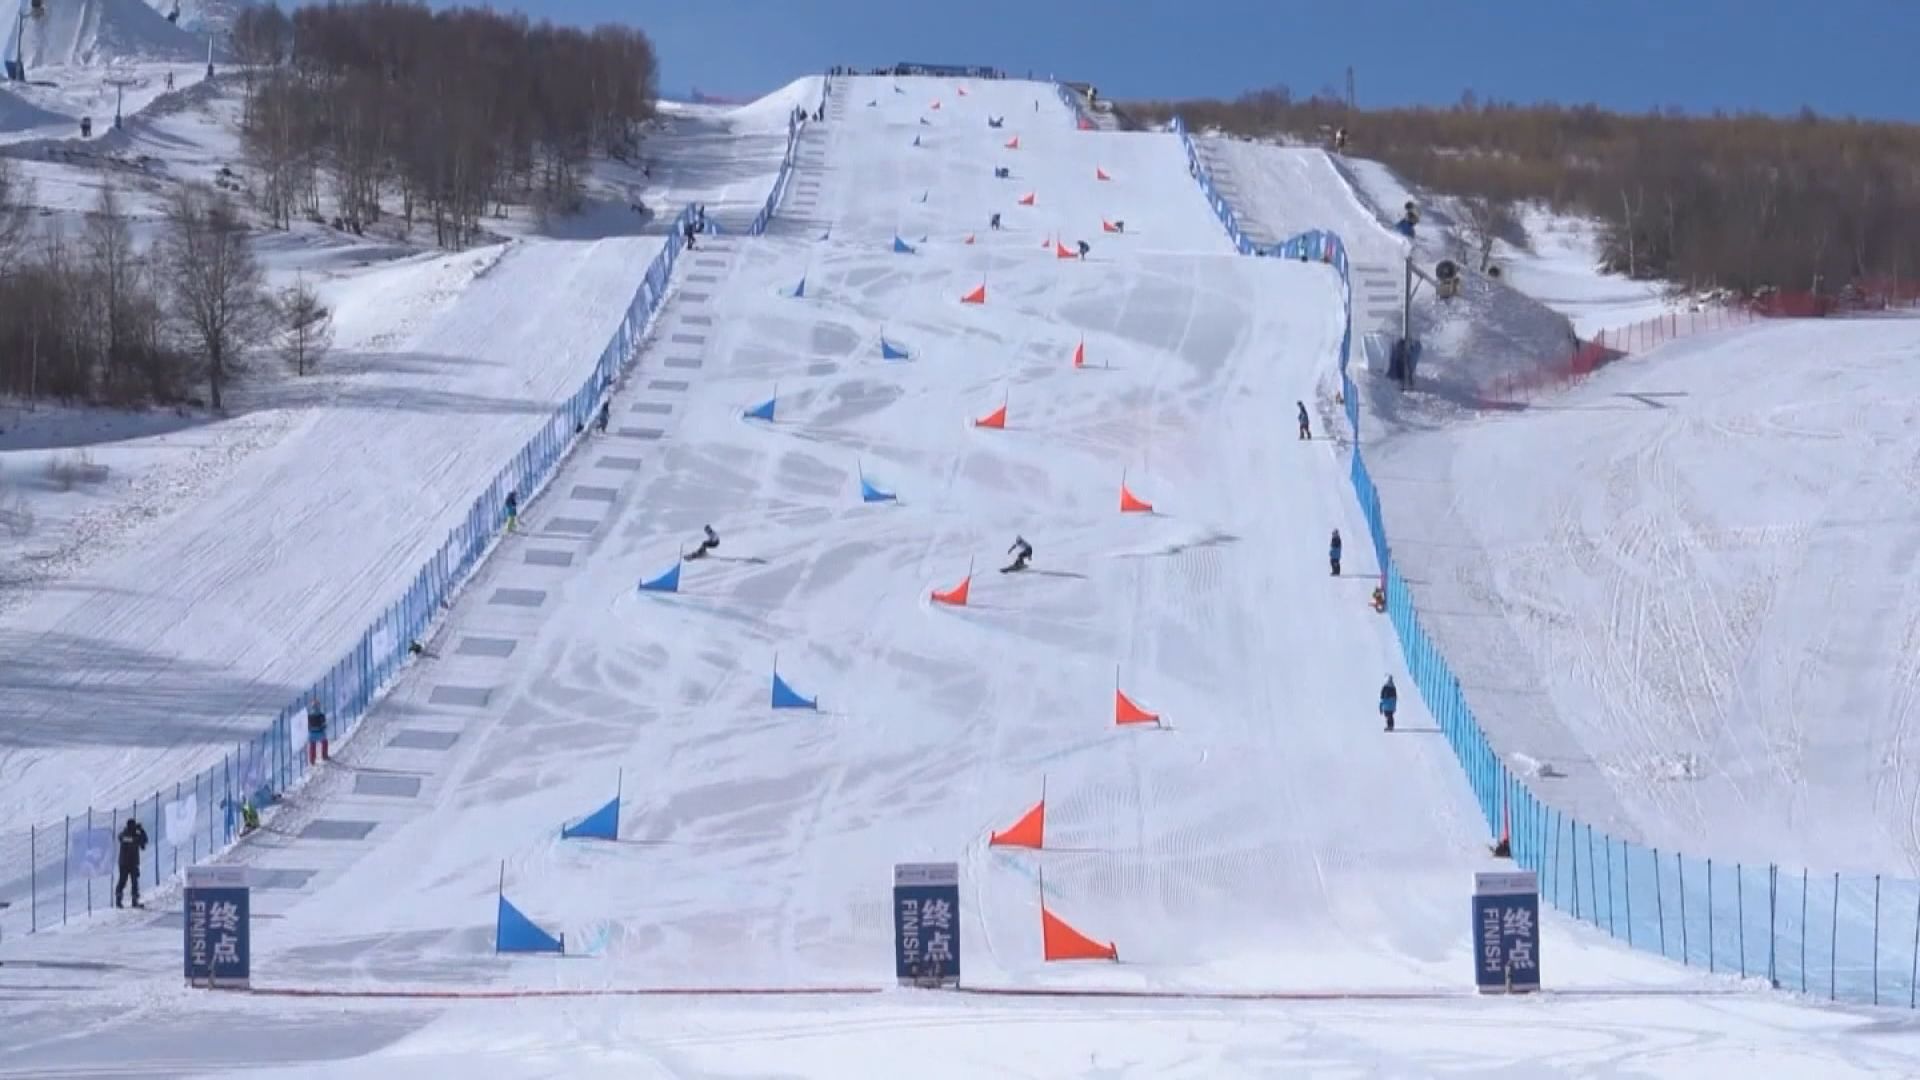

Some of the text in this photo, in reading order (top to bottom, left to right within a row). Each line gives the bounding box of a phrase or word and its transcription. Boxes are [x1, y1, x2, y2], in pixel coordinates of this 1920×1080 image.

[192, 900, 206, 965] FINISH
[209, 901, 240, 963] 终点
[902, 900, 920, 963] FINISH
[922, 899, 953, 961] 终点
[1483, 908, 1501, 971] FINISH
[1503, 907, 1536, 970] 终点
